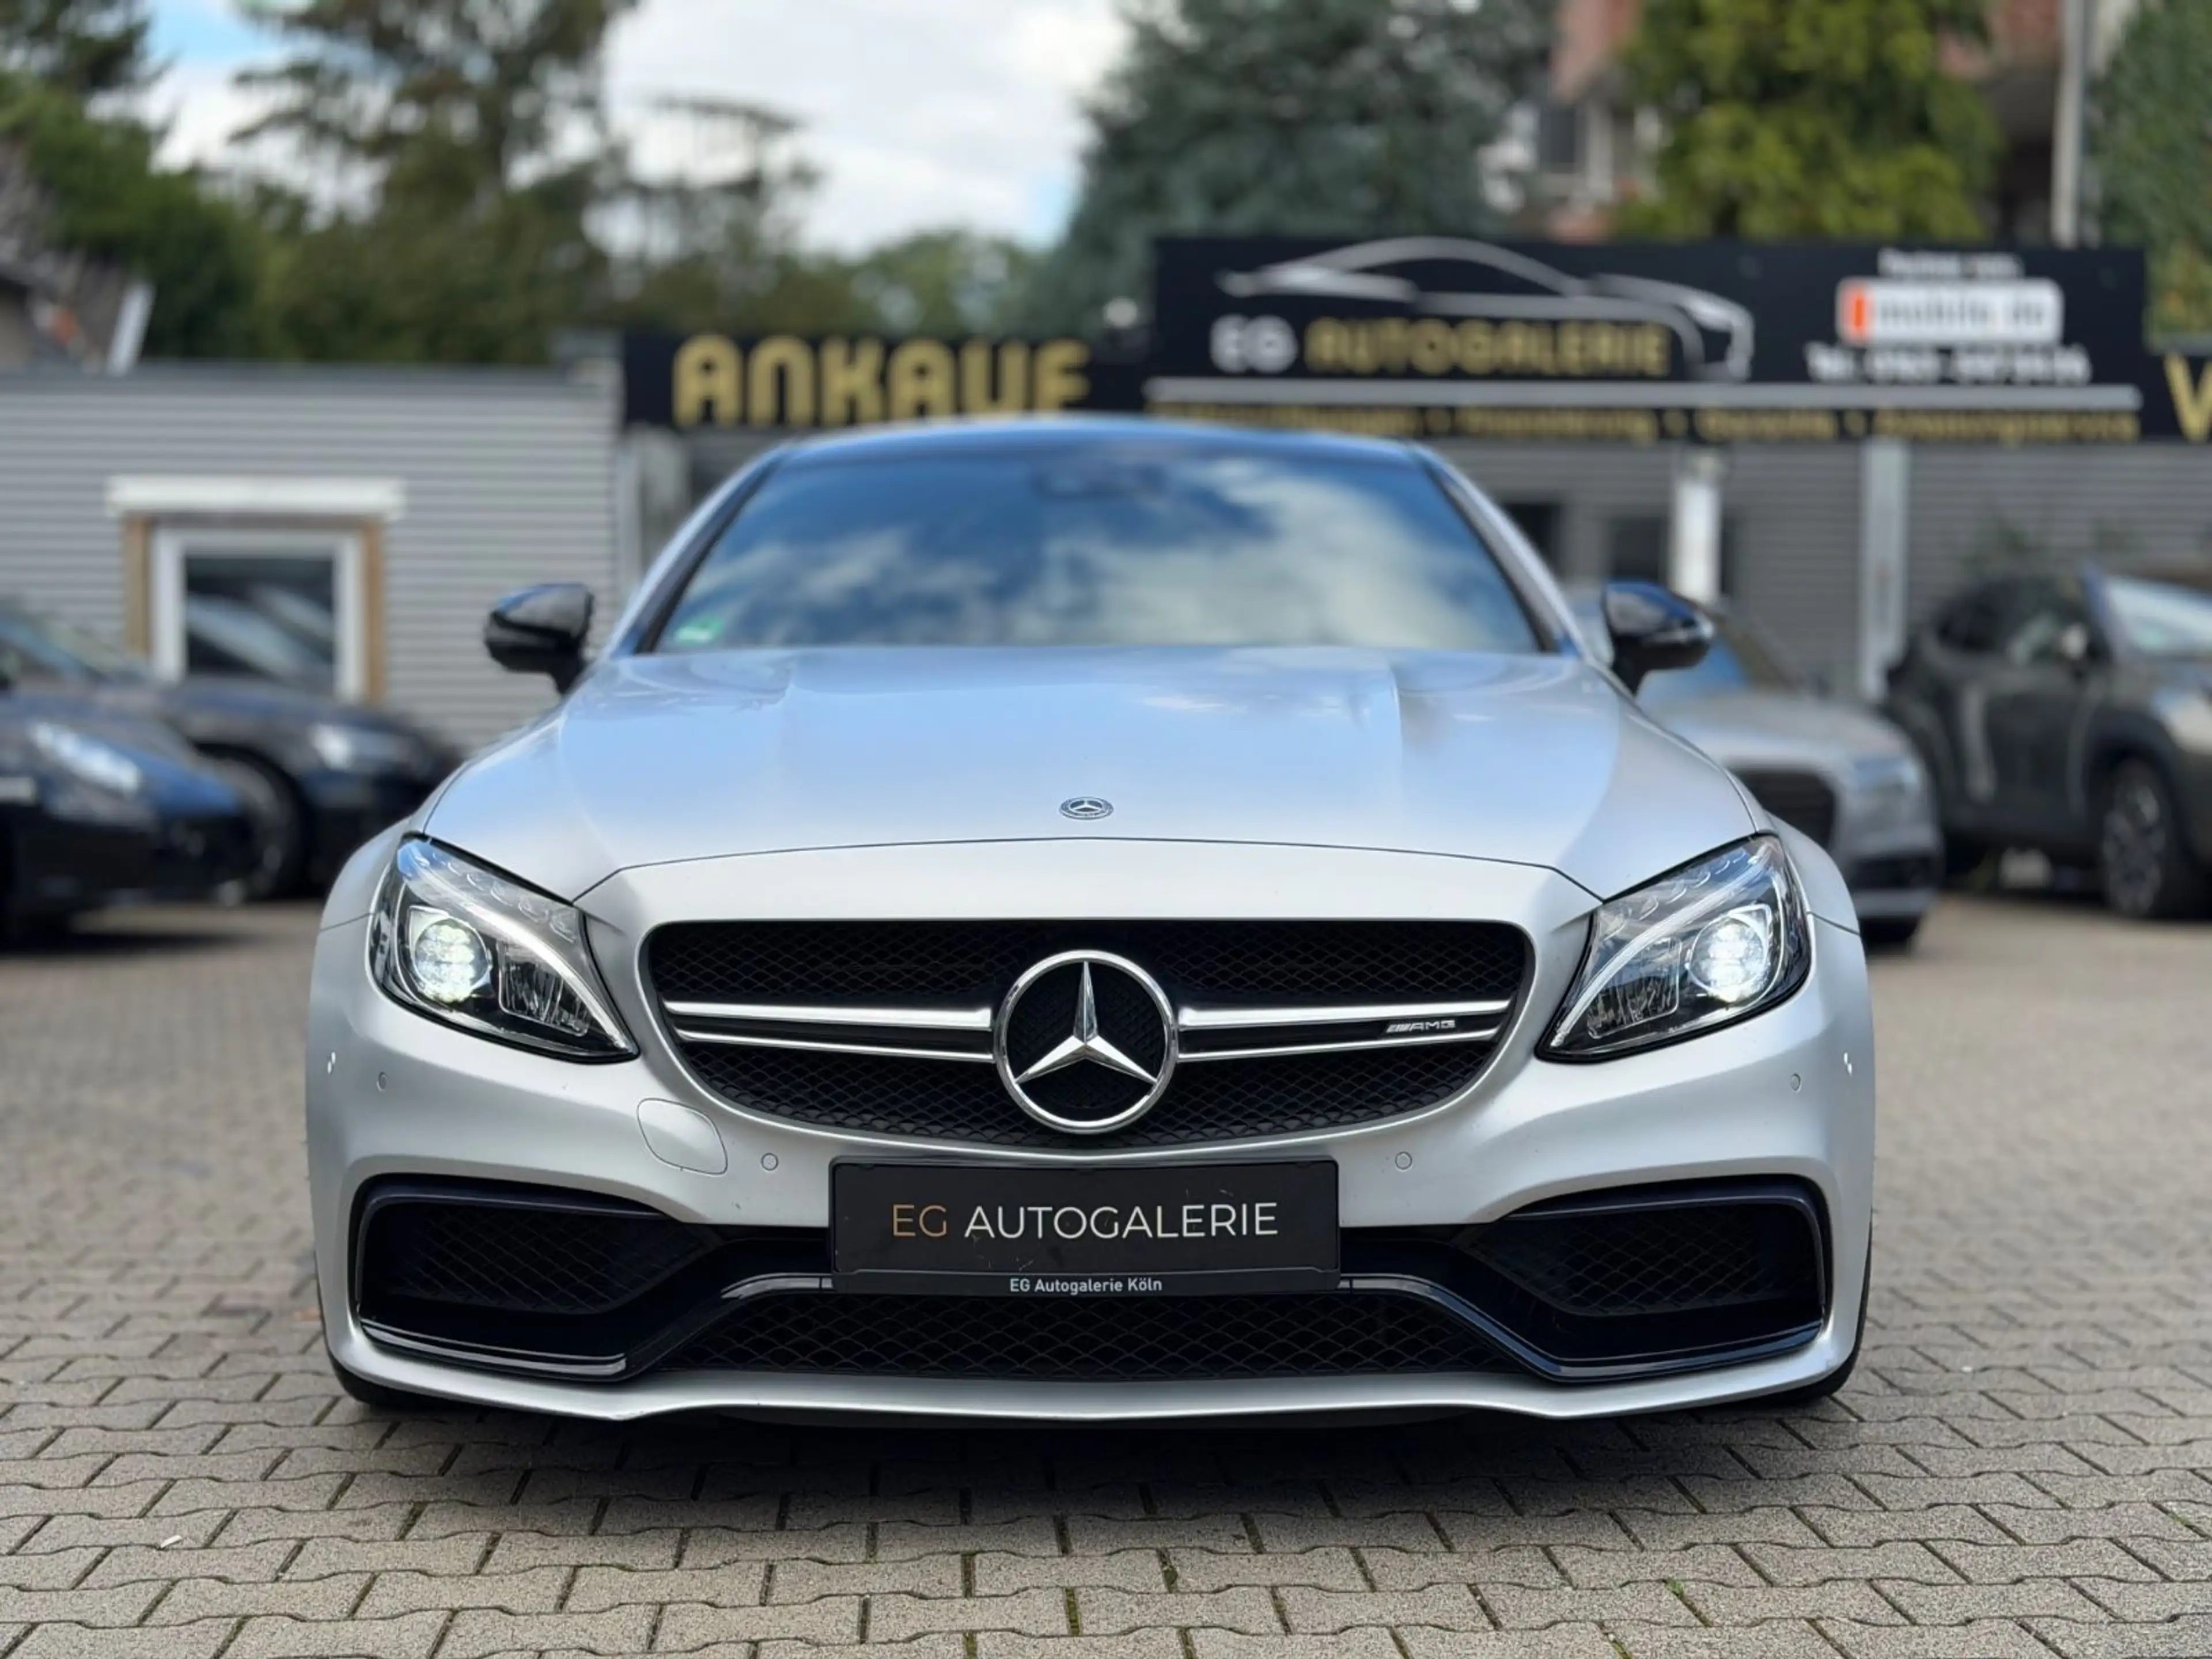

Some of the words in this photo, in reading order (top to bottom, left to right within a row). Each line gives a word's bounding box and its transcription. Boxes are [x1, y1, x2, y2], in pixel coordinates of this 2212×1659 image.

[1304, 318, 1671, 376] AUTOGALERIE
[672, 334, 1090, 429] ANKAUF
[892, 1204, 947, 1238] EG
[964, 1202, 1279, 1239] AUTOGALERIE
[1010, 1278, 1030, 1292] EG
[1034, 1278, 1123, 1295] Autogalerie
[1127, 1277, 1162, 1291] Köln
